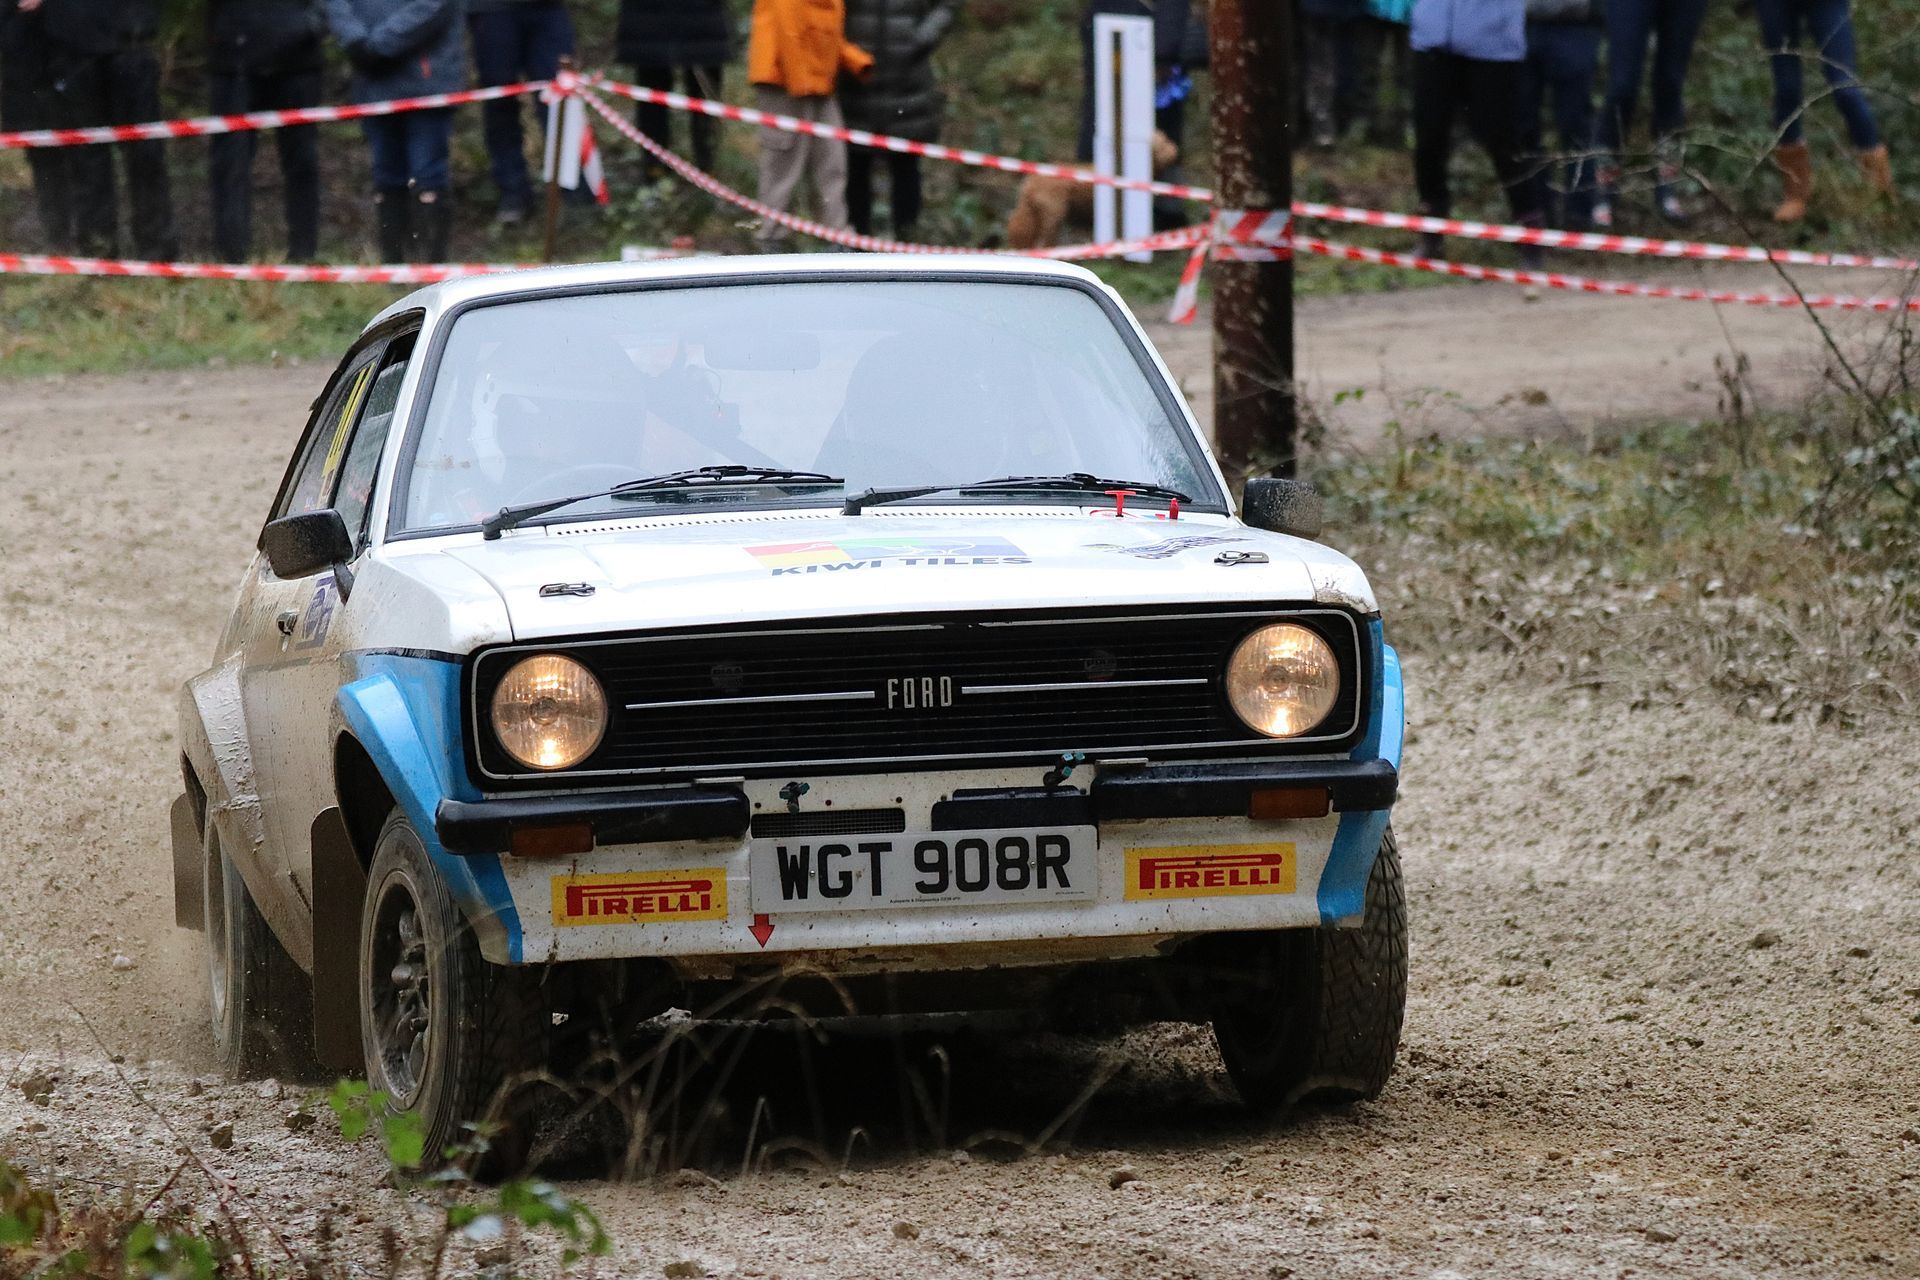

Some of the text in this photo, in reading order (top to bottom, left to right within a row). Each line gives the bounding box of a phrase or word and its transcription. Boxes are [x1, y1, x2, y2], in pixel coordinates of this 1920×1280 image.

[771, 557, 1033, 577] KIWI TILES
[887, 675, 953, 709] FORD
[776, 834, 1071, 901] WGT 908R
[1139, 853, 1283, 890] PIRELLI
[566, 879, 713, 917] PIRELLI
